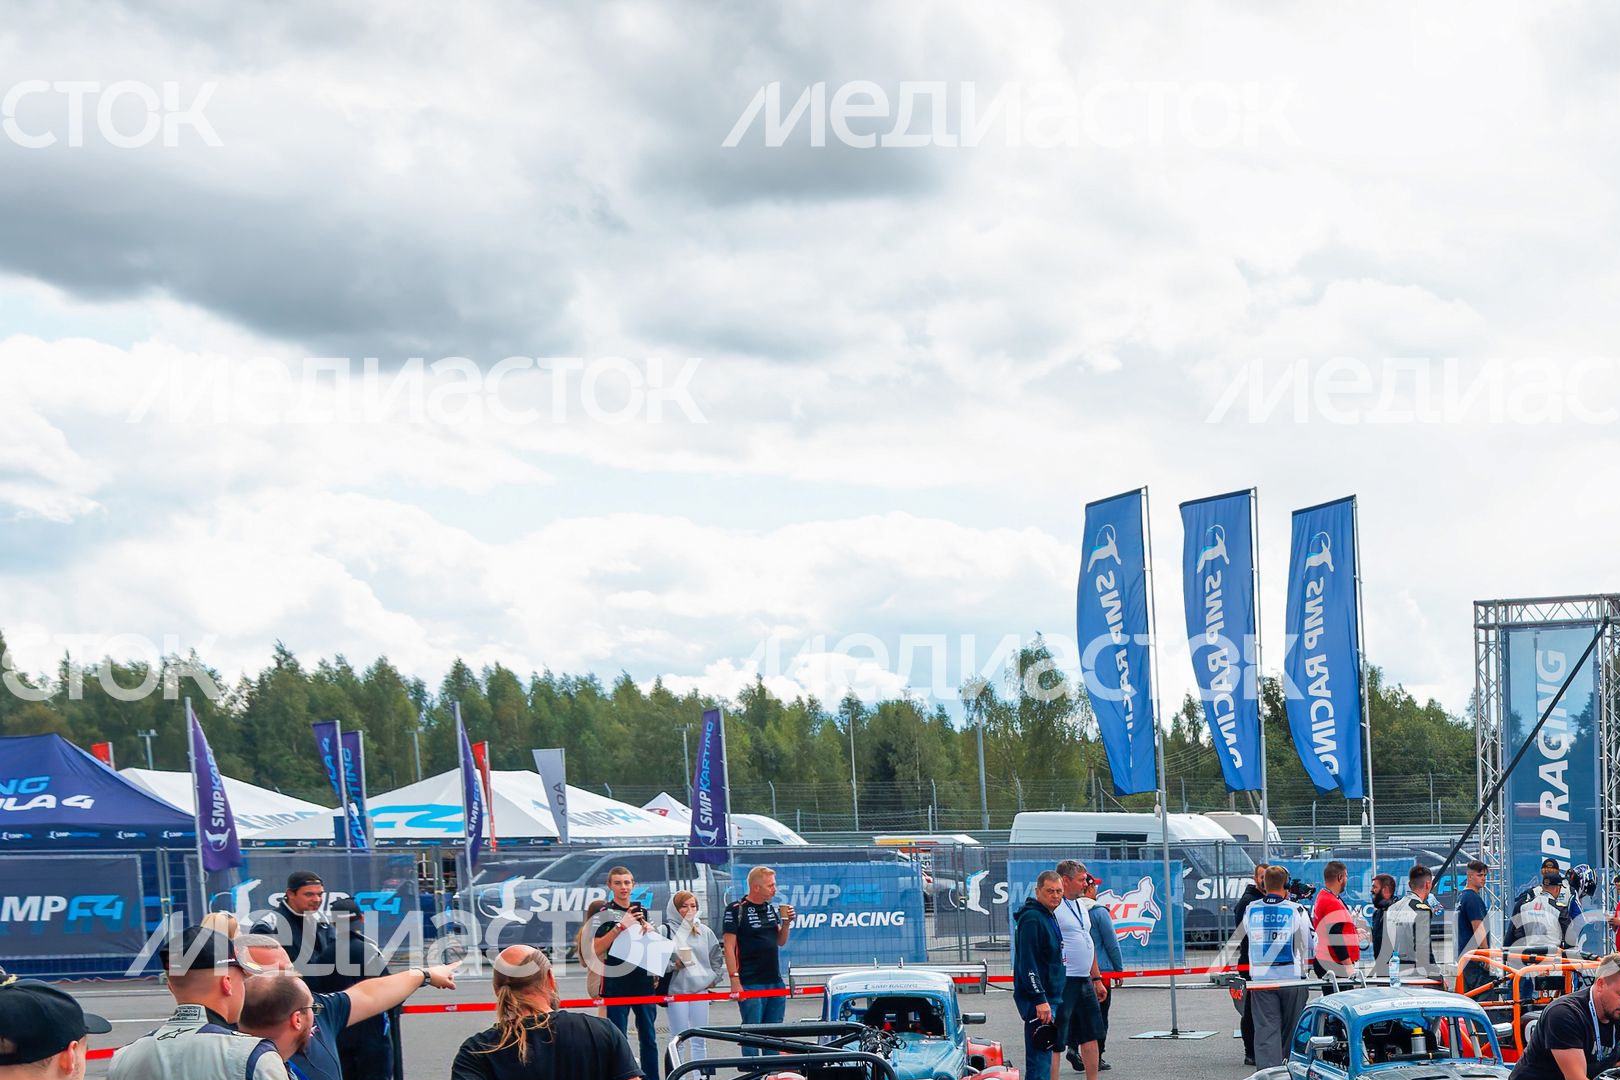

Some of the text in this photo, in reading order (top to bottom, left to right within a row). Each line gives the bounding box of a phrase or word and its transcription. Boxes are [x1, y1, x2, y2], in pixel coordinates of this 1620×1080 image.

[1535, 648, 1571, 822] RACING
[699, 720, 714, 826] SMPKARTING
[0, 894, 124, 921] MPF4
[789, 911, 905, 929] MP RACING
[1250, 913, 1291, 925] ПРЕССА
[1271, 931, 1289, 941] 011
